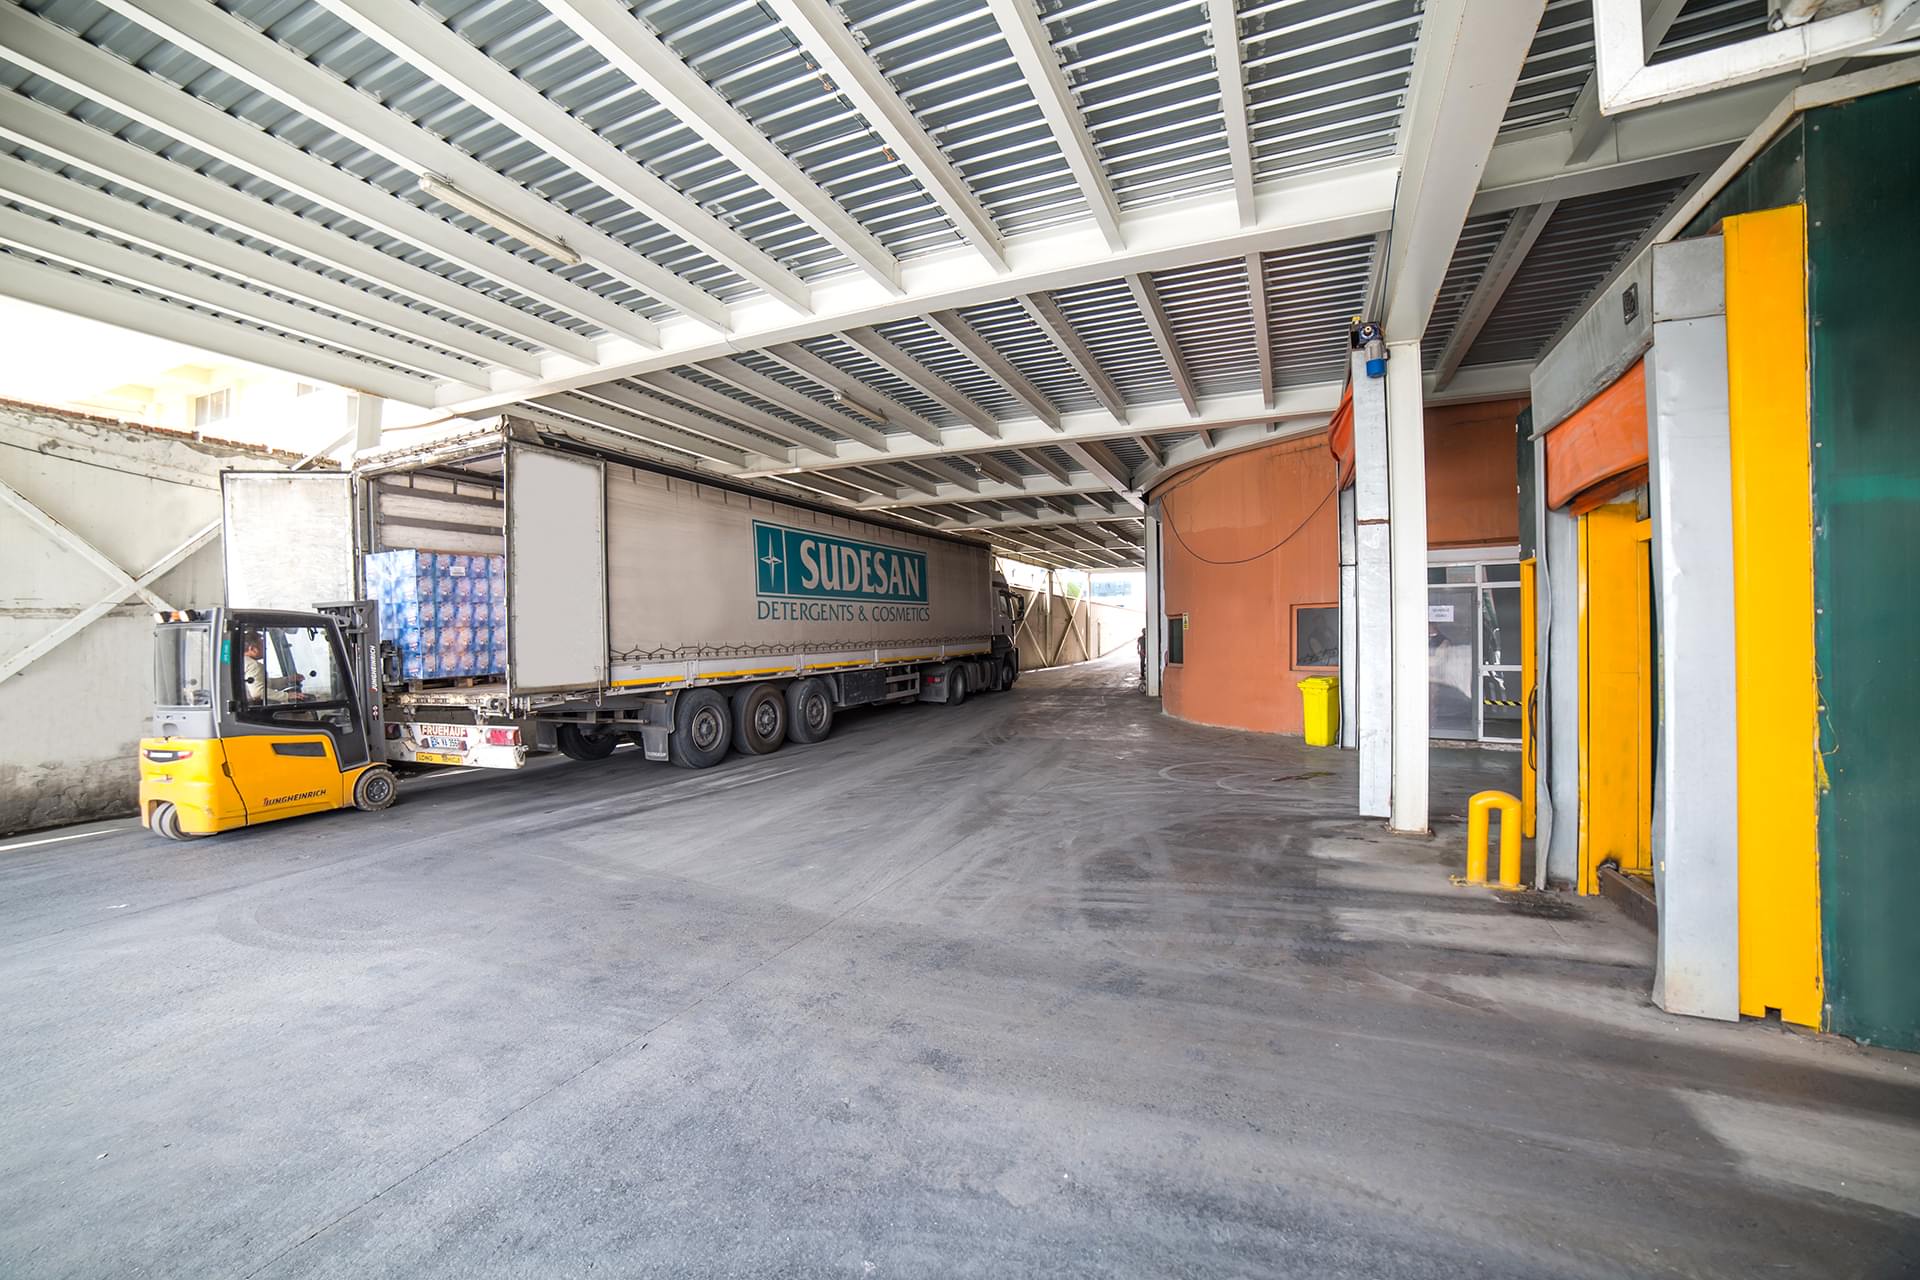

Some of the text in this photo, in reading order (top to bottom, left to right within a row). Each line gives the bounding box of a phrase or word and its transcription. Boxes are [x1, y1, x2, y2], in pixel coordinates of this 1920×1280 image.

[800, 539, 920, 597] SUDESAN
[758, 600, 930, 622] DETERGENTS & COSMETICS
[368, 645, 378, 692] JUNGHEINRICH
[423, 725, 467, 737] FRUEHAUF
[263, 788, 327, 806] JUNGHEINRICH
